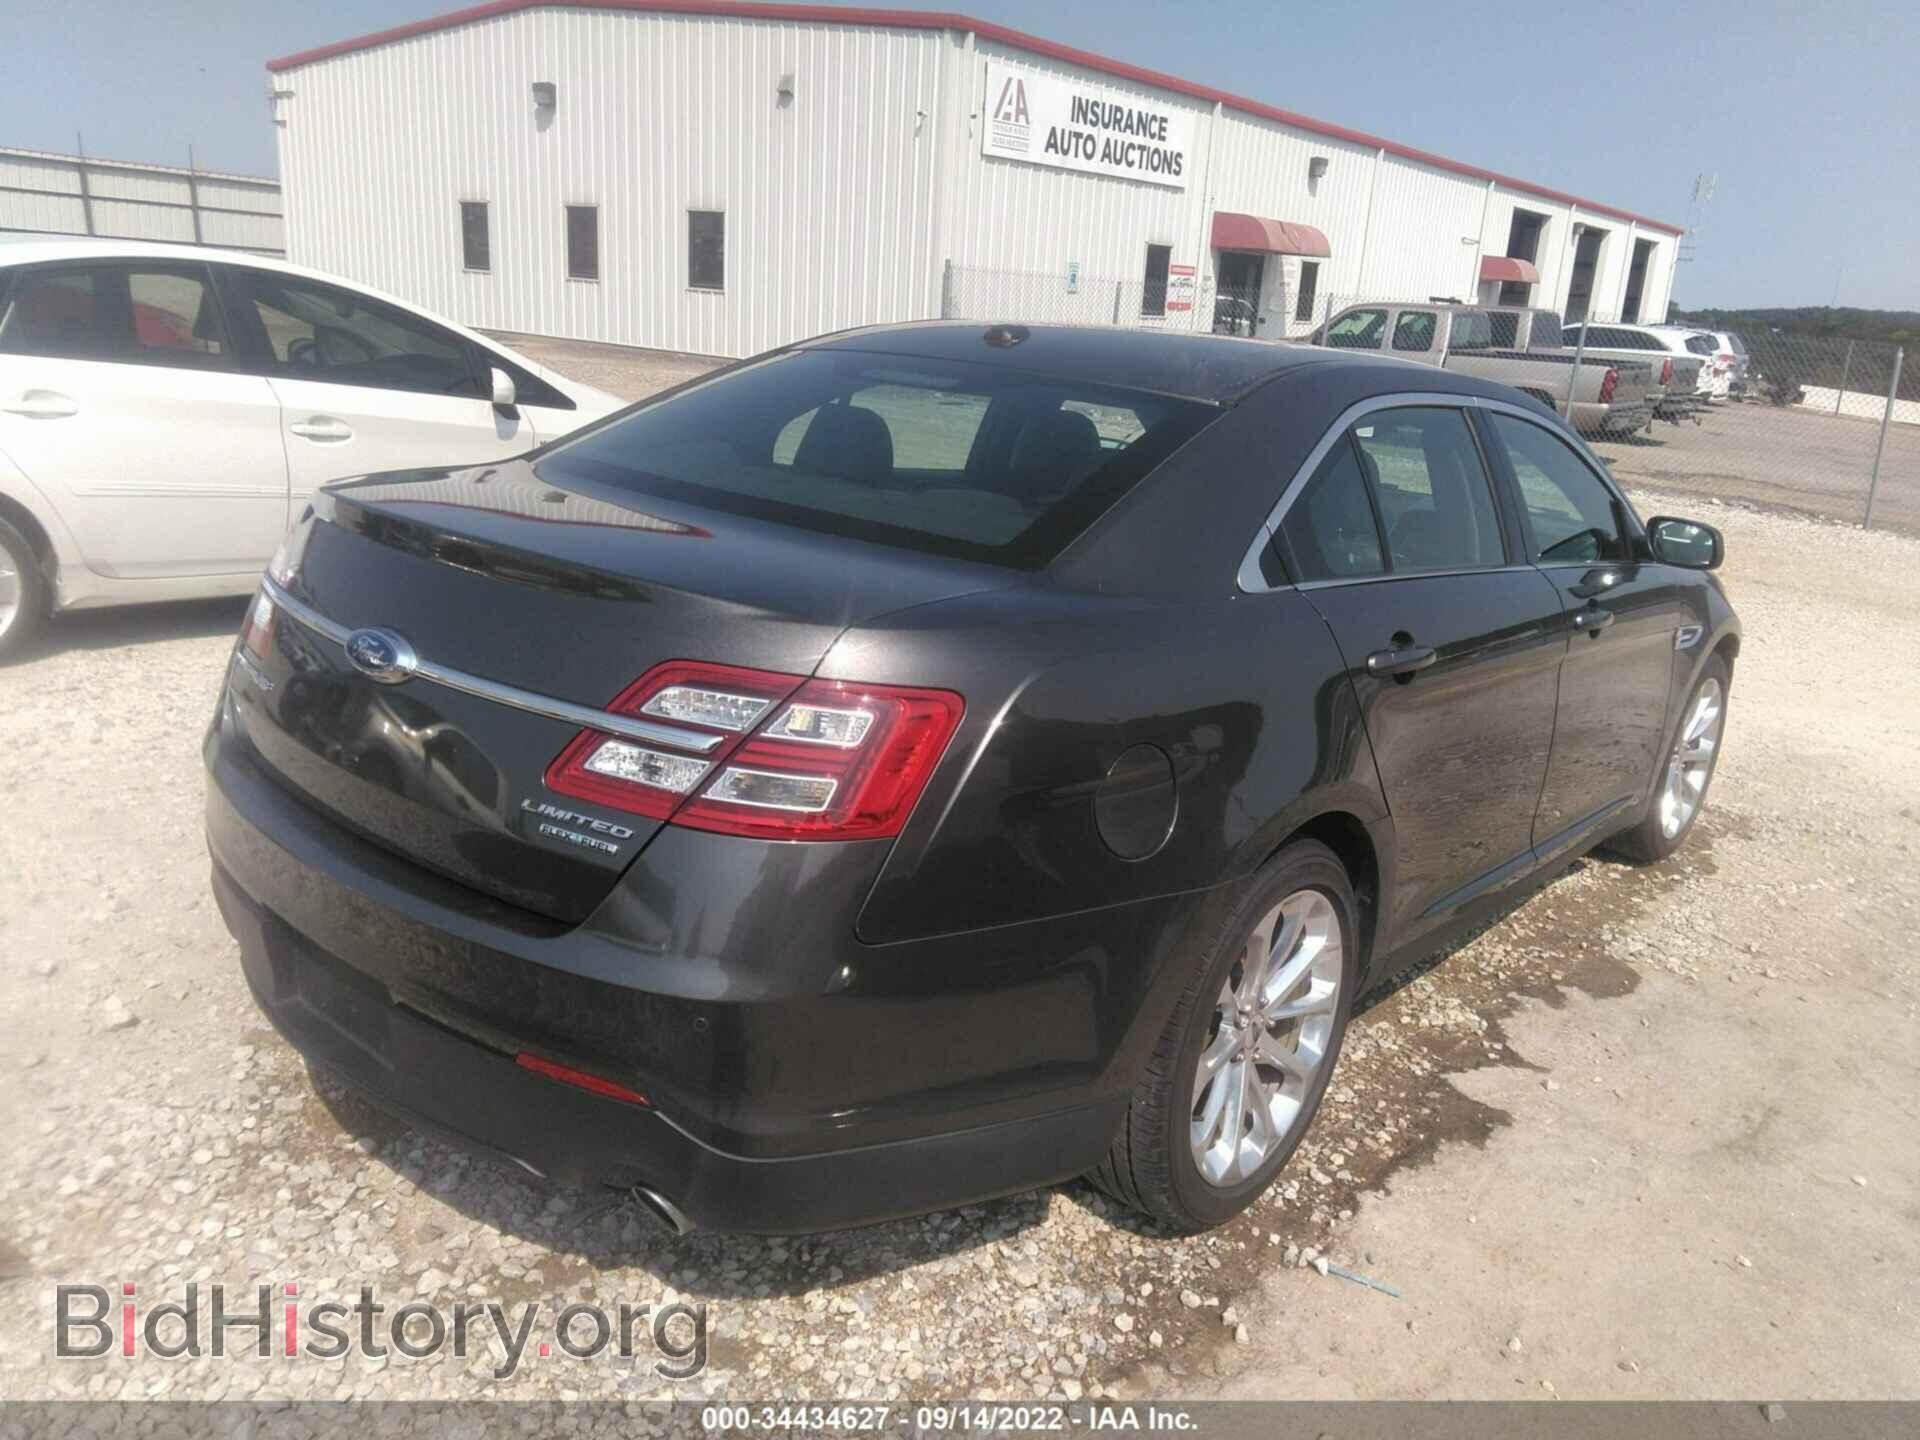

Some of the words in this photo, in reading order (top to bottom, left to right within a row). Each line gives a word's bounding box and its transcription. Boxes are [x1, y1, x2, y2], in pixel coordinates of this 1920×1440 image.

[1070, 96, 1168, 141] INSURANCE
[1044, 126, 1096, 160] AUTO
[1100, 138, 1183, 176] AUCTIONS
[521, 799, 634, 839] LIMITED
